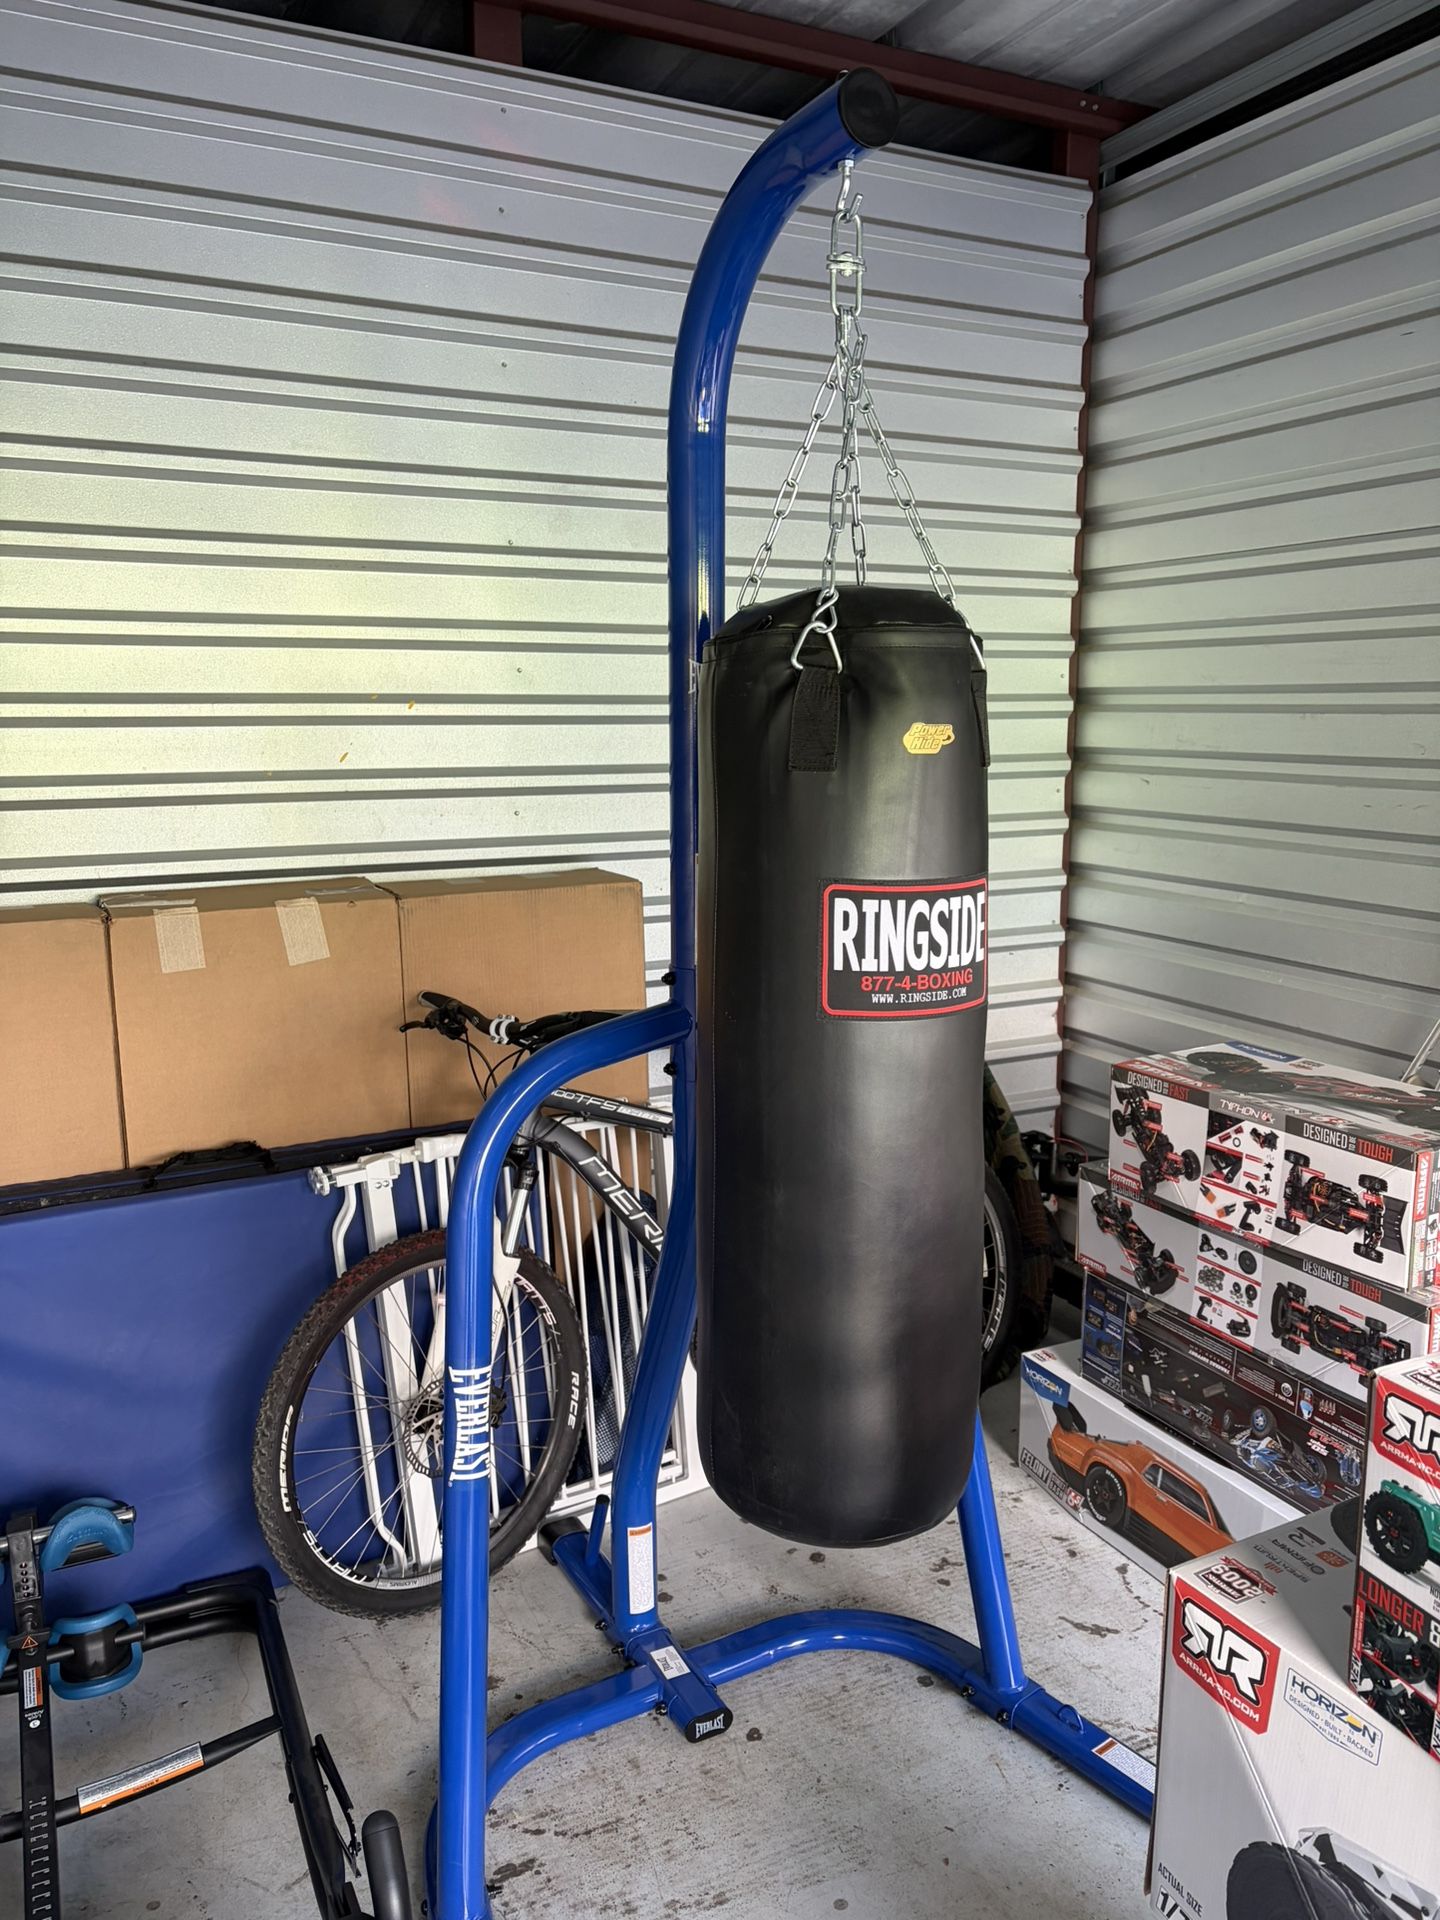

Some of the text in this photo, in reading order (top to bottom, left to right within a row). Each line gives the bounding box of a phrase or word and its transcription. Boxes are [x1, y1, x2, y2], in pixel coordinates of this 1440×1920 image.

[909, 723, 951, 736] Power
[910, 737, 940, 749] Hide
[833, 891, 985, 972] RINGSIDE
[861, 968, 973, 991] 877-4-BOXING
[872, 987, 967, 1004] WWW.RINGSIDE.COM
[1128, 1071, 1162, 1093] DESIGNED
[1169, 1083, 1189, 1101] FAST
[1220, 1099, 1260, 1119] TYPHON
[1303, 1122, 1348, 1149] DESIGNED
[1358, 1138, 1394, 1163] TOUGH
[1302, 1260, 1342, 1286] DESIGNED
[1349, 1279, 1382, 1303] TOUGH
[567, 1371, 580, 1430] RACE
[1025, 1368, 1063, 1396] HORIZON
[448, 1364, 492, 1480] EVERLAST
[279, 1405, 294, 1512] MERIDA
[1021, 1450, 1050, 1483] FELONY
[1211, 1564, 1263, 1598] 2009
[1253, 1544, 1312, 1583] SPEKTRUM
[1357, 1571, 1425, 1637] LONGER
[1179, 1652, 1260, 1722] ARRMA-RC.COM
[1350, 1649, 1362, 1692] NEW
[695, 1712, 726, 1739] EVERLAST
[1289, 1694, 1374, 1758] DESIGNED BUILT BACKED
[1291, 1675, 1377, 1744] HORIZON
[1158, 1862, 1203, 1918] ACTUAL SIZE
